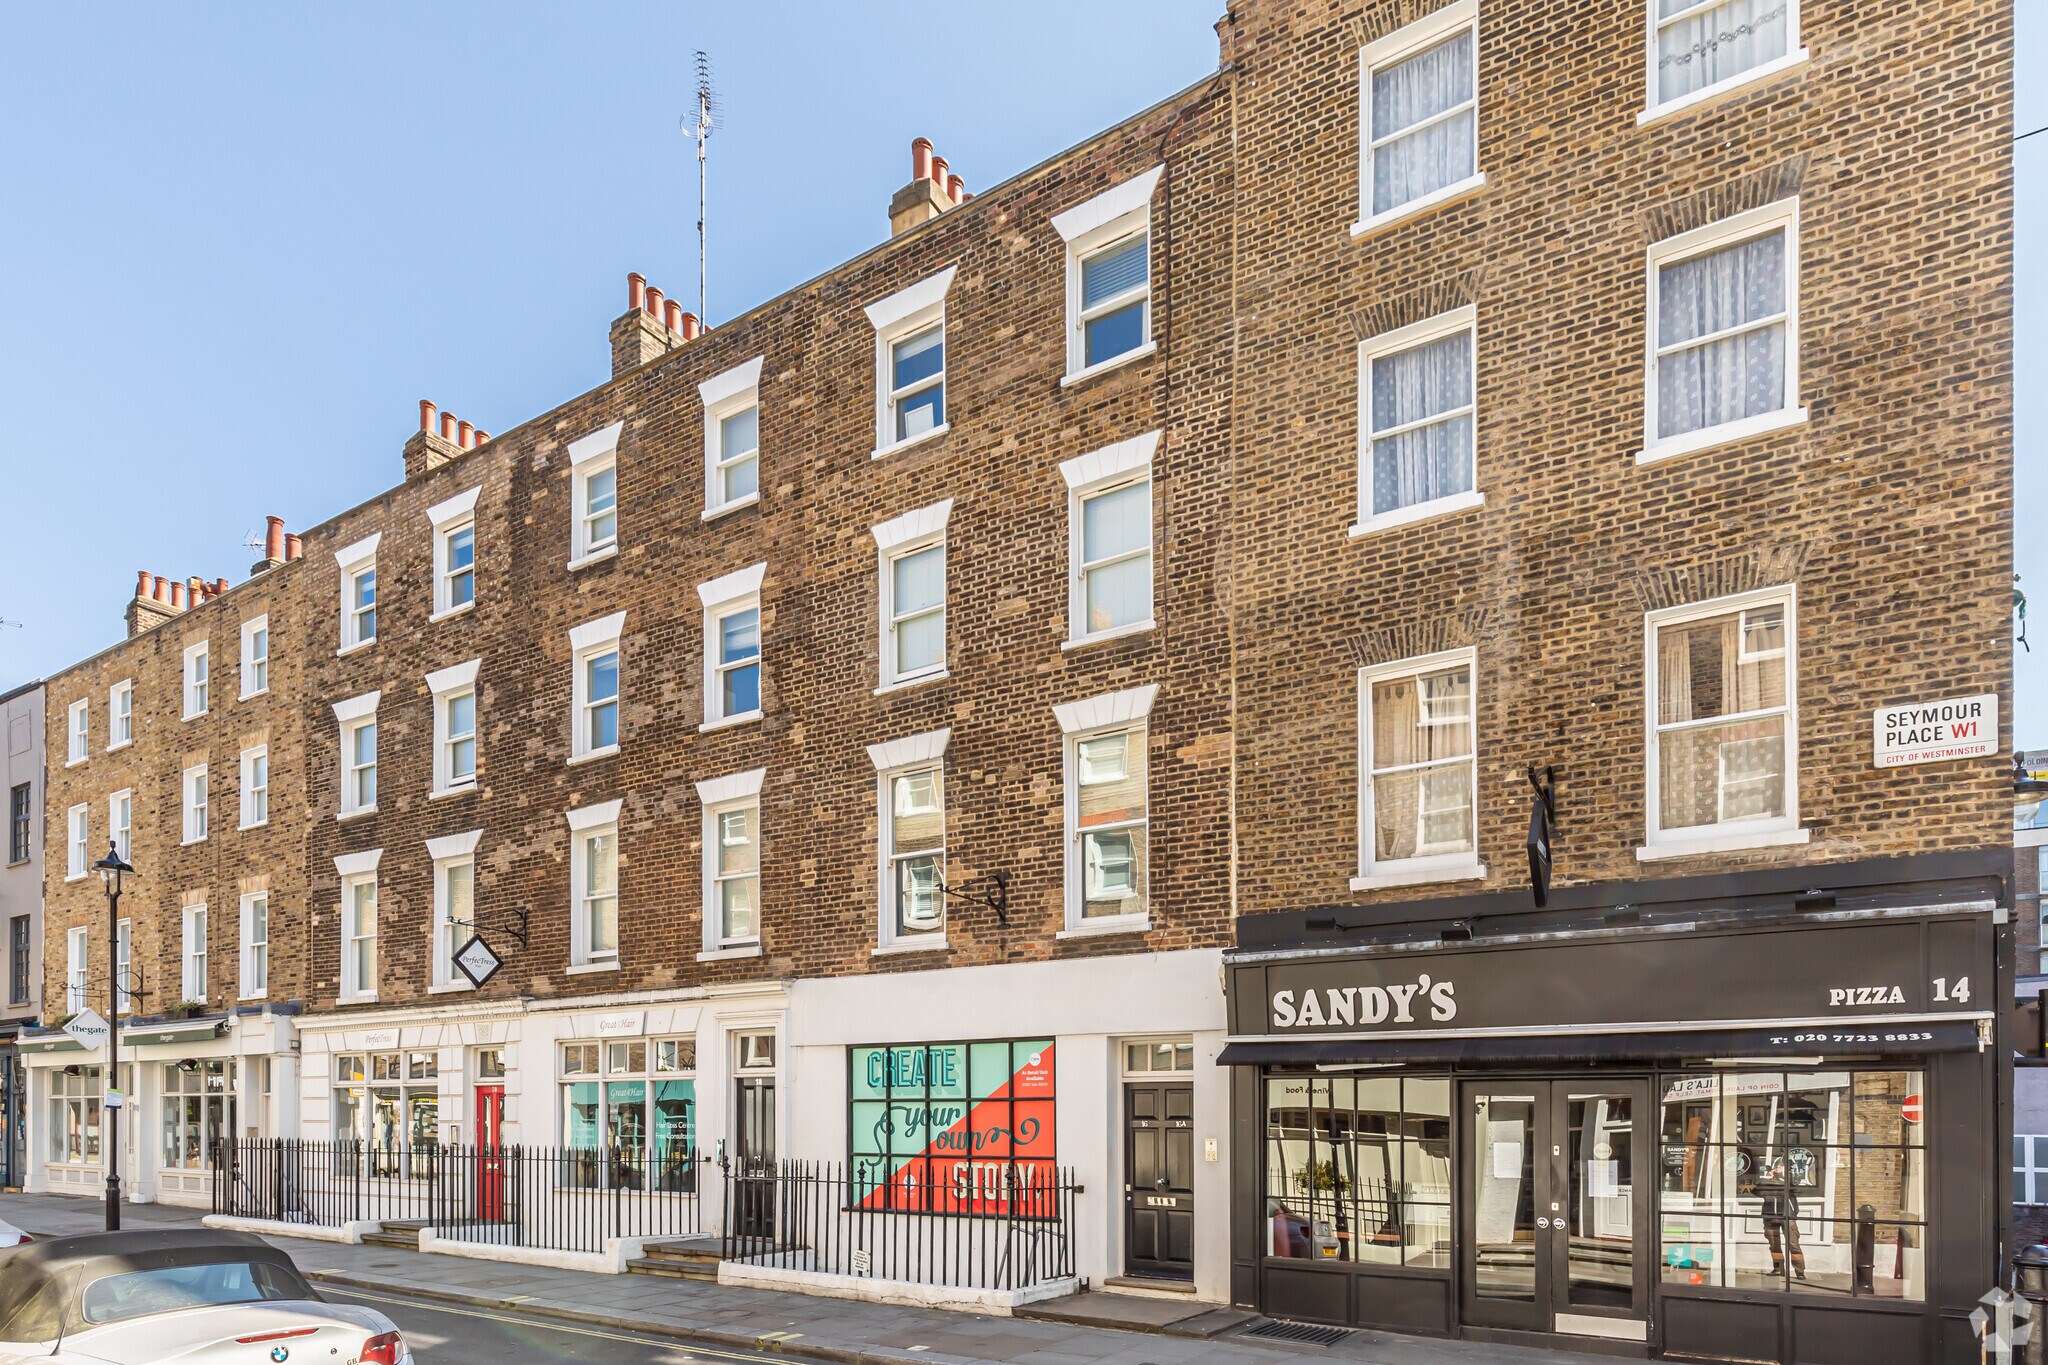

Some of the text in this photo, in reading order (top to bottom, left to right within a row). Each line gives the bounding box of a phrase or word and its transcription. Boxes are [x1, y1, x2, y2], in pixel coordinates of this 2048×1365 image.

[1886, 702, 1982, 728] SEYMOUR
[1886, 721, 1977, 747] PLACE W1
[1886, 745, 1986, 764] CITY OF WESTMINSTER
[462, 955, 495, 966] PerfecTress
[1273, 973, 1457, 1027] SANDY'S
[1829, 976, 1971, 1006] PIZZA 14
[72, 1025, 107, 1036] thegate
[1794, 1034, 1827, 1043] 020
[1832, 1034, 1879, 1042] 7723
[1884, 1032, 1933, 1042] 8833
[866, 1048, 957, 1088] CREATE
[754, 1078, 763, 1086] 18
